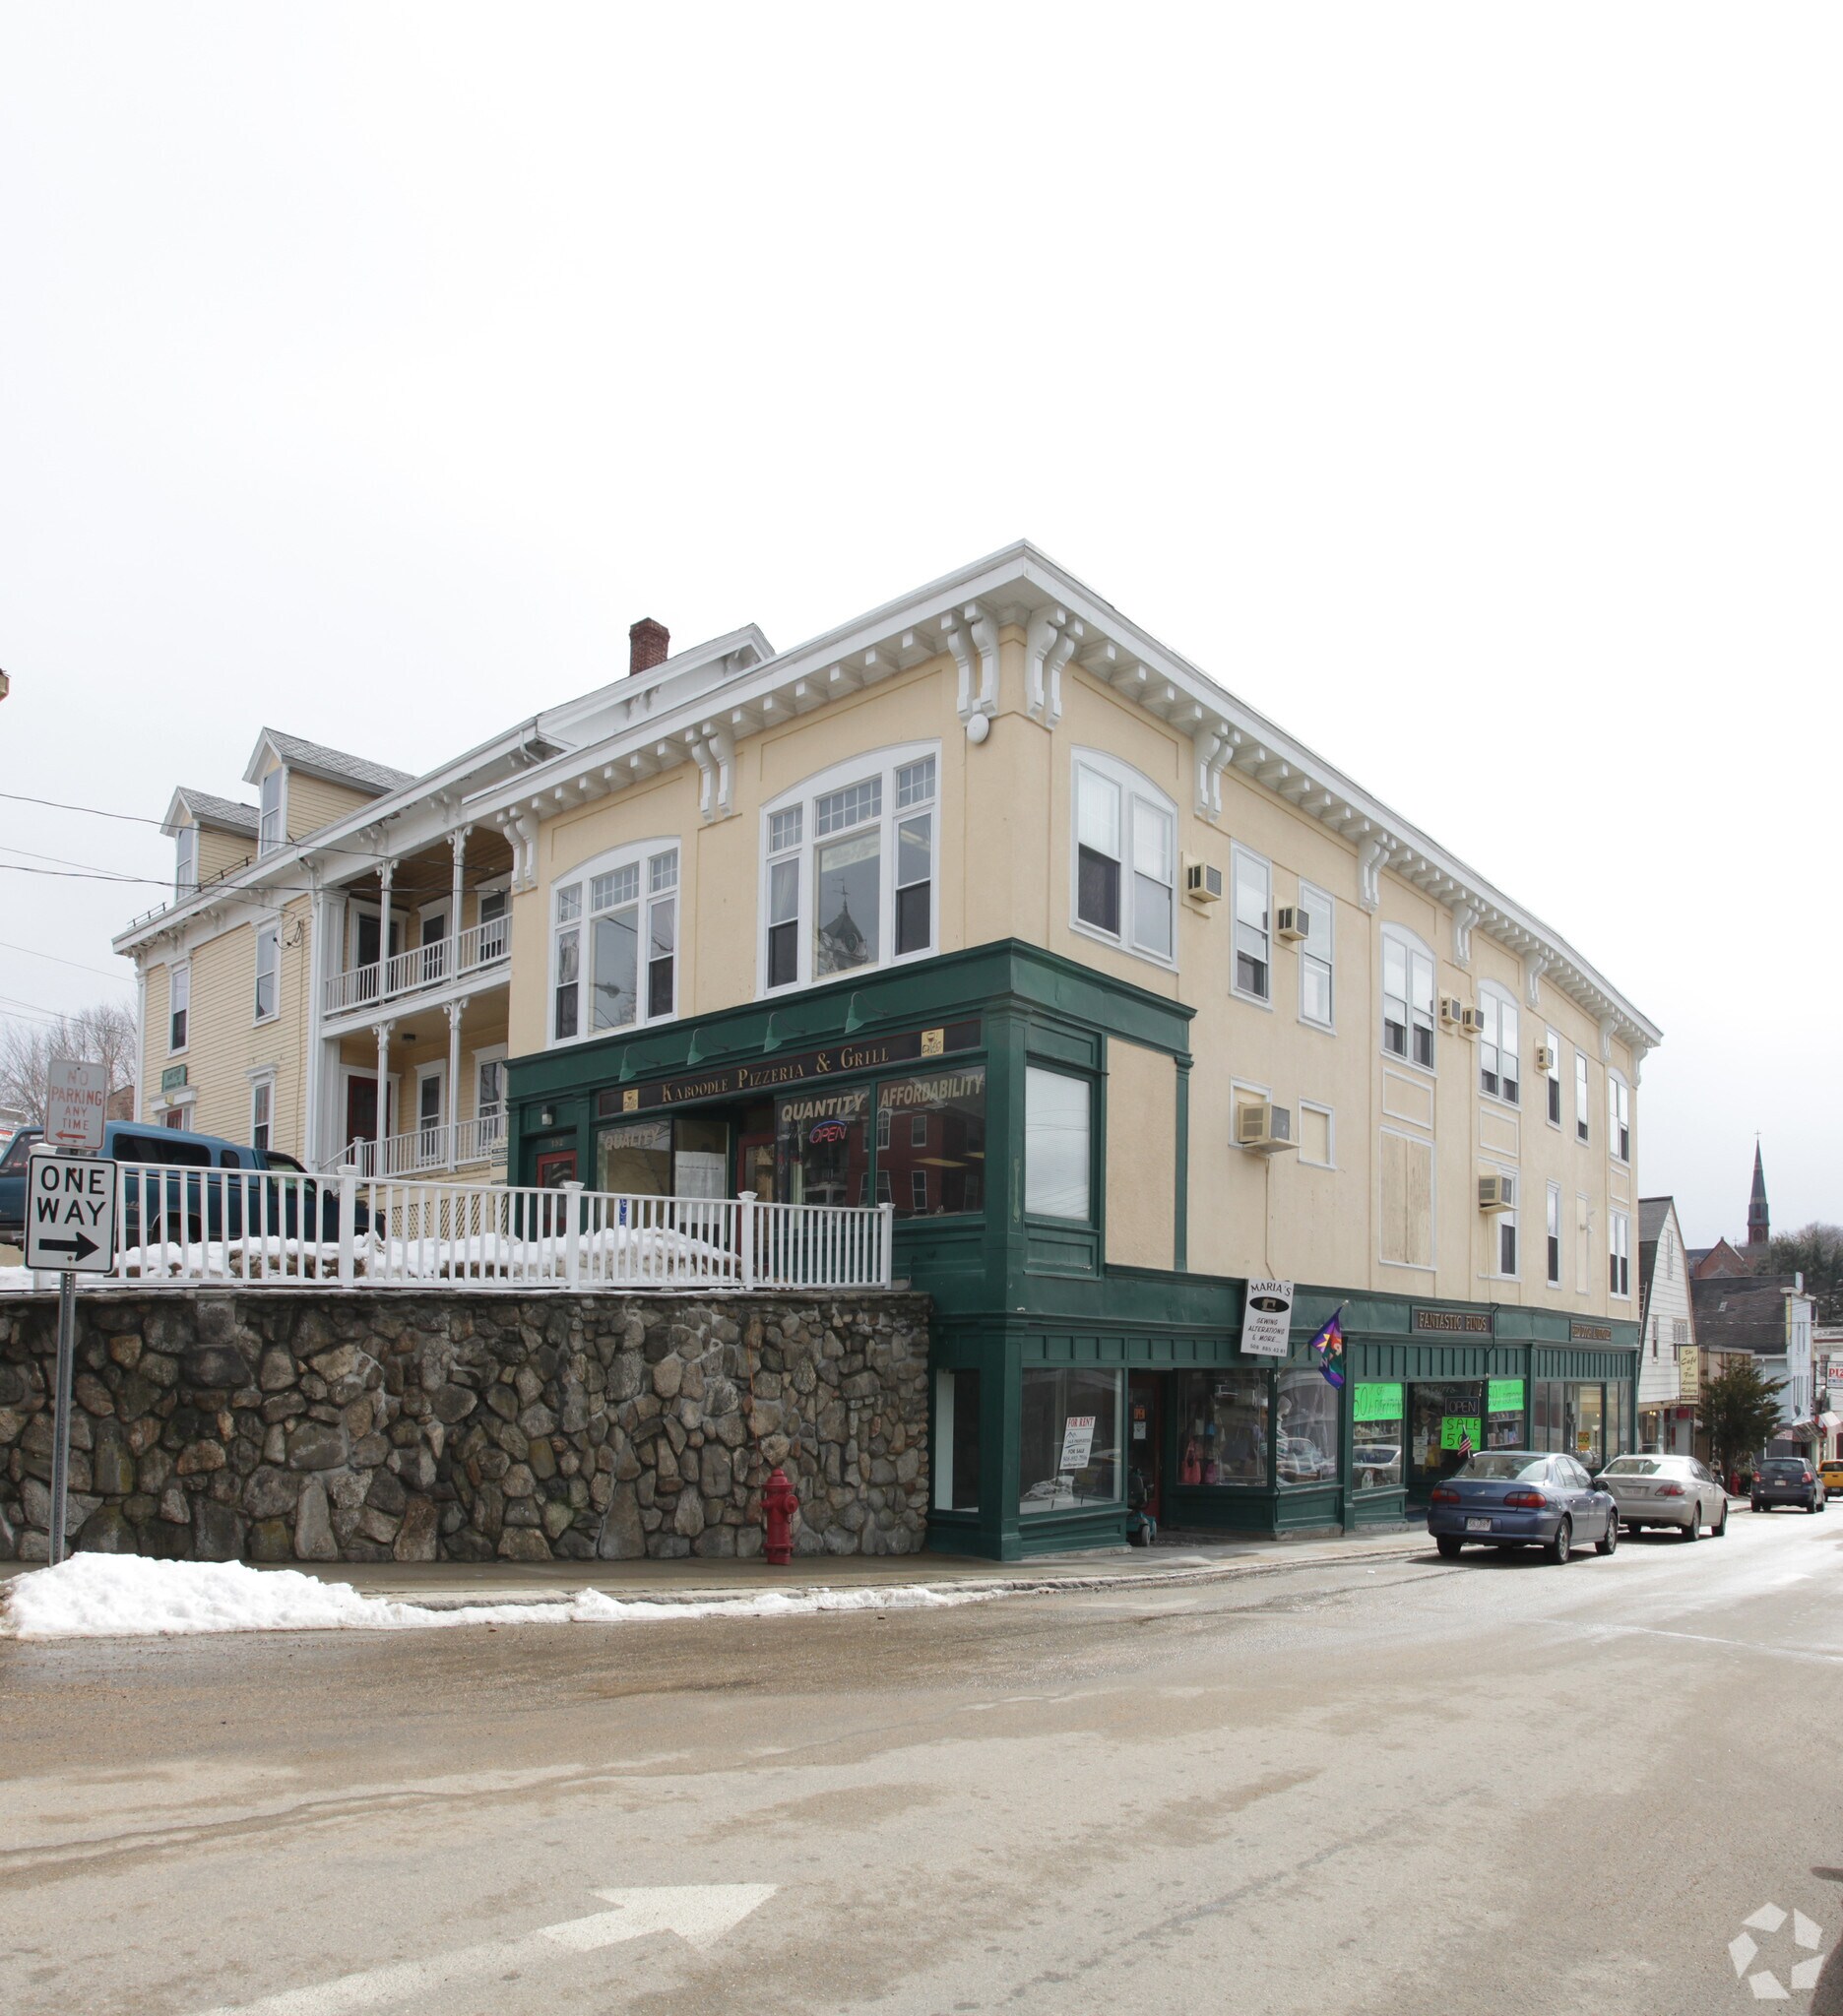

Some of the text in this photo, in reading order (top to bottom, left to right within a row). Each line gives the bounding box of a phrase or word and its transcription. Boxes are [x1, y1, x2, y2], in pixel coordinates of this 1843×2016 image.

[67, 1069, 89, 1086] NO
[662, 1047, 889, 1102] KABOODLE PIZZERIA & GRILL
[51, 1086, 102, 1106] PARKING
[880, 1073, 985, 1108] AFFORDABILITY
[64, 1105, 88, 1117] ANY
[781, 1093, 865, 1122] QUANTITY
[62, 1117, 90, 1131] TIME
[604, 1128, 659, 1151] QUALITY
[810, 1126, 847, 1144] OPEN
[41, 1165, 105, 1195] ONE
[36, 1196, 106, 1227] WAY
[1250, 1282, 1292, 1296] MARIA'S
[1419, 1312, 1487, 1331] FANTASTIC FINDS
[1449, 1401, 1476, 1413] OPEN
[1067, 1418, 1095, 1427] FOR RENT
[1447, 1418, 1480, 1431] SALE
